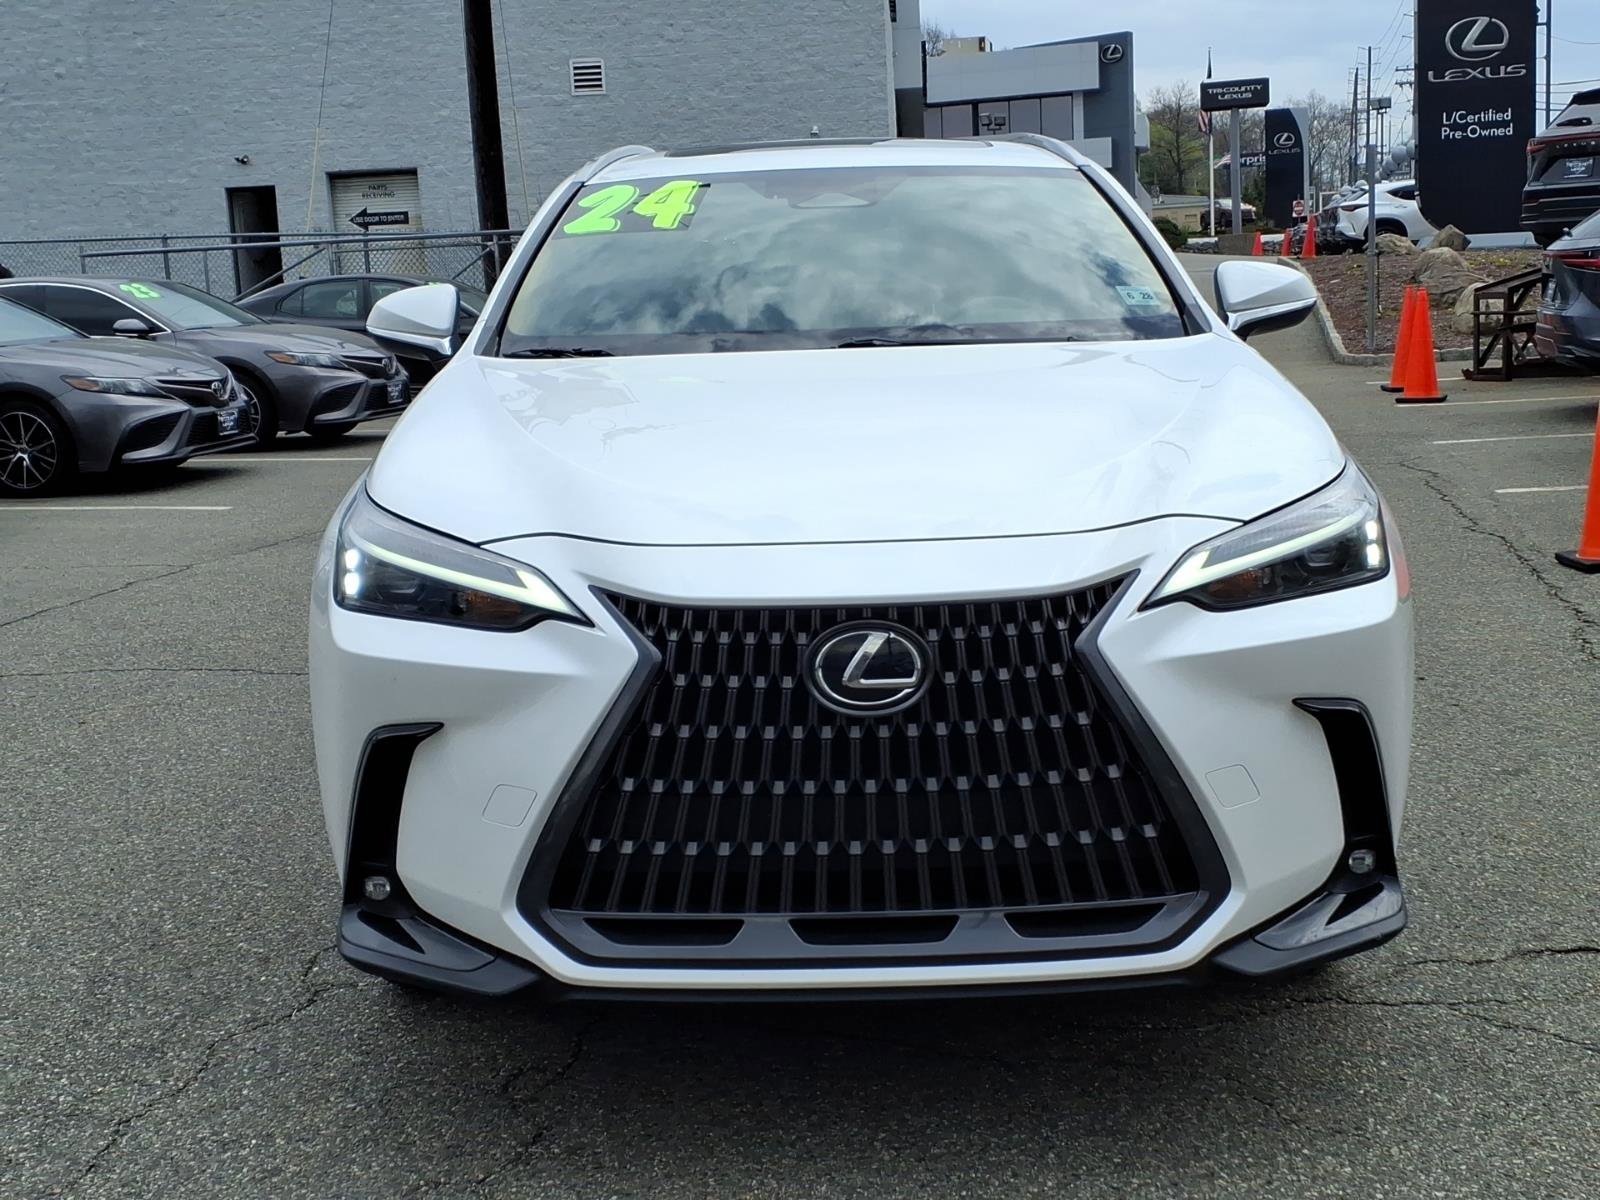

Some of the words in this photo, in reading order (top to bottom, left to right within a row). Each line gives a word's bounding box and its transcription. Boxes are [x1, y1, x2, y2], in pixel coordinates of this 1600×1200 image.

[1428, 64, 1527, 82] LEXUS
[1207, 84, 1263, 94] TRI-COUNTY
[1218, 91, 1252, 100] LEXUS
[1442, 107, 1512, 124] L/Certified
[1441, 123, 1513, 139] Pre-Owned
[1268, 147, 1301, 155] LEXUS
[361, 191, 396, 199] RECEIVING
[564, 180, 702, 234] 24
[119, 283, 160, 298] 23
